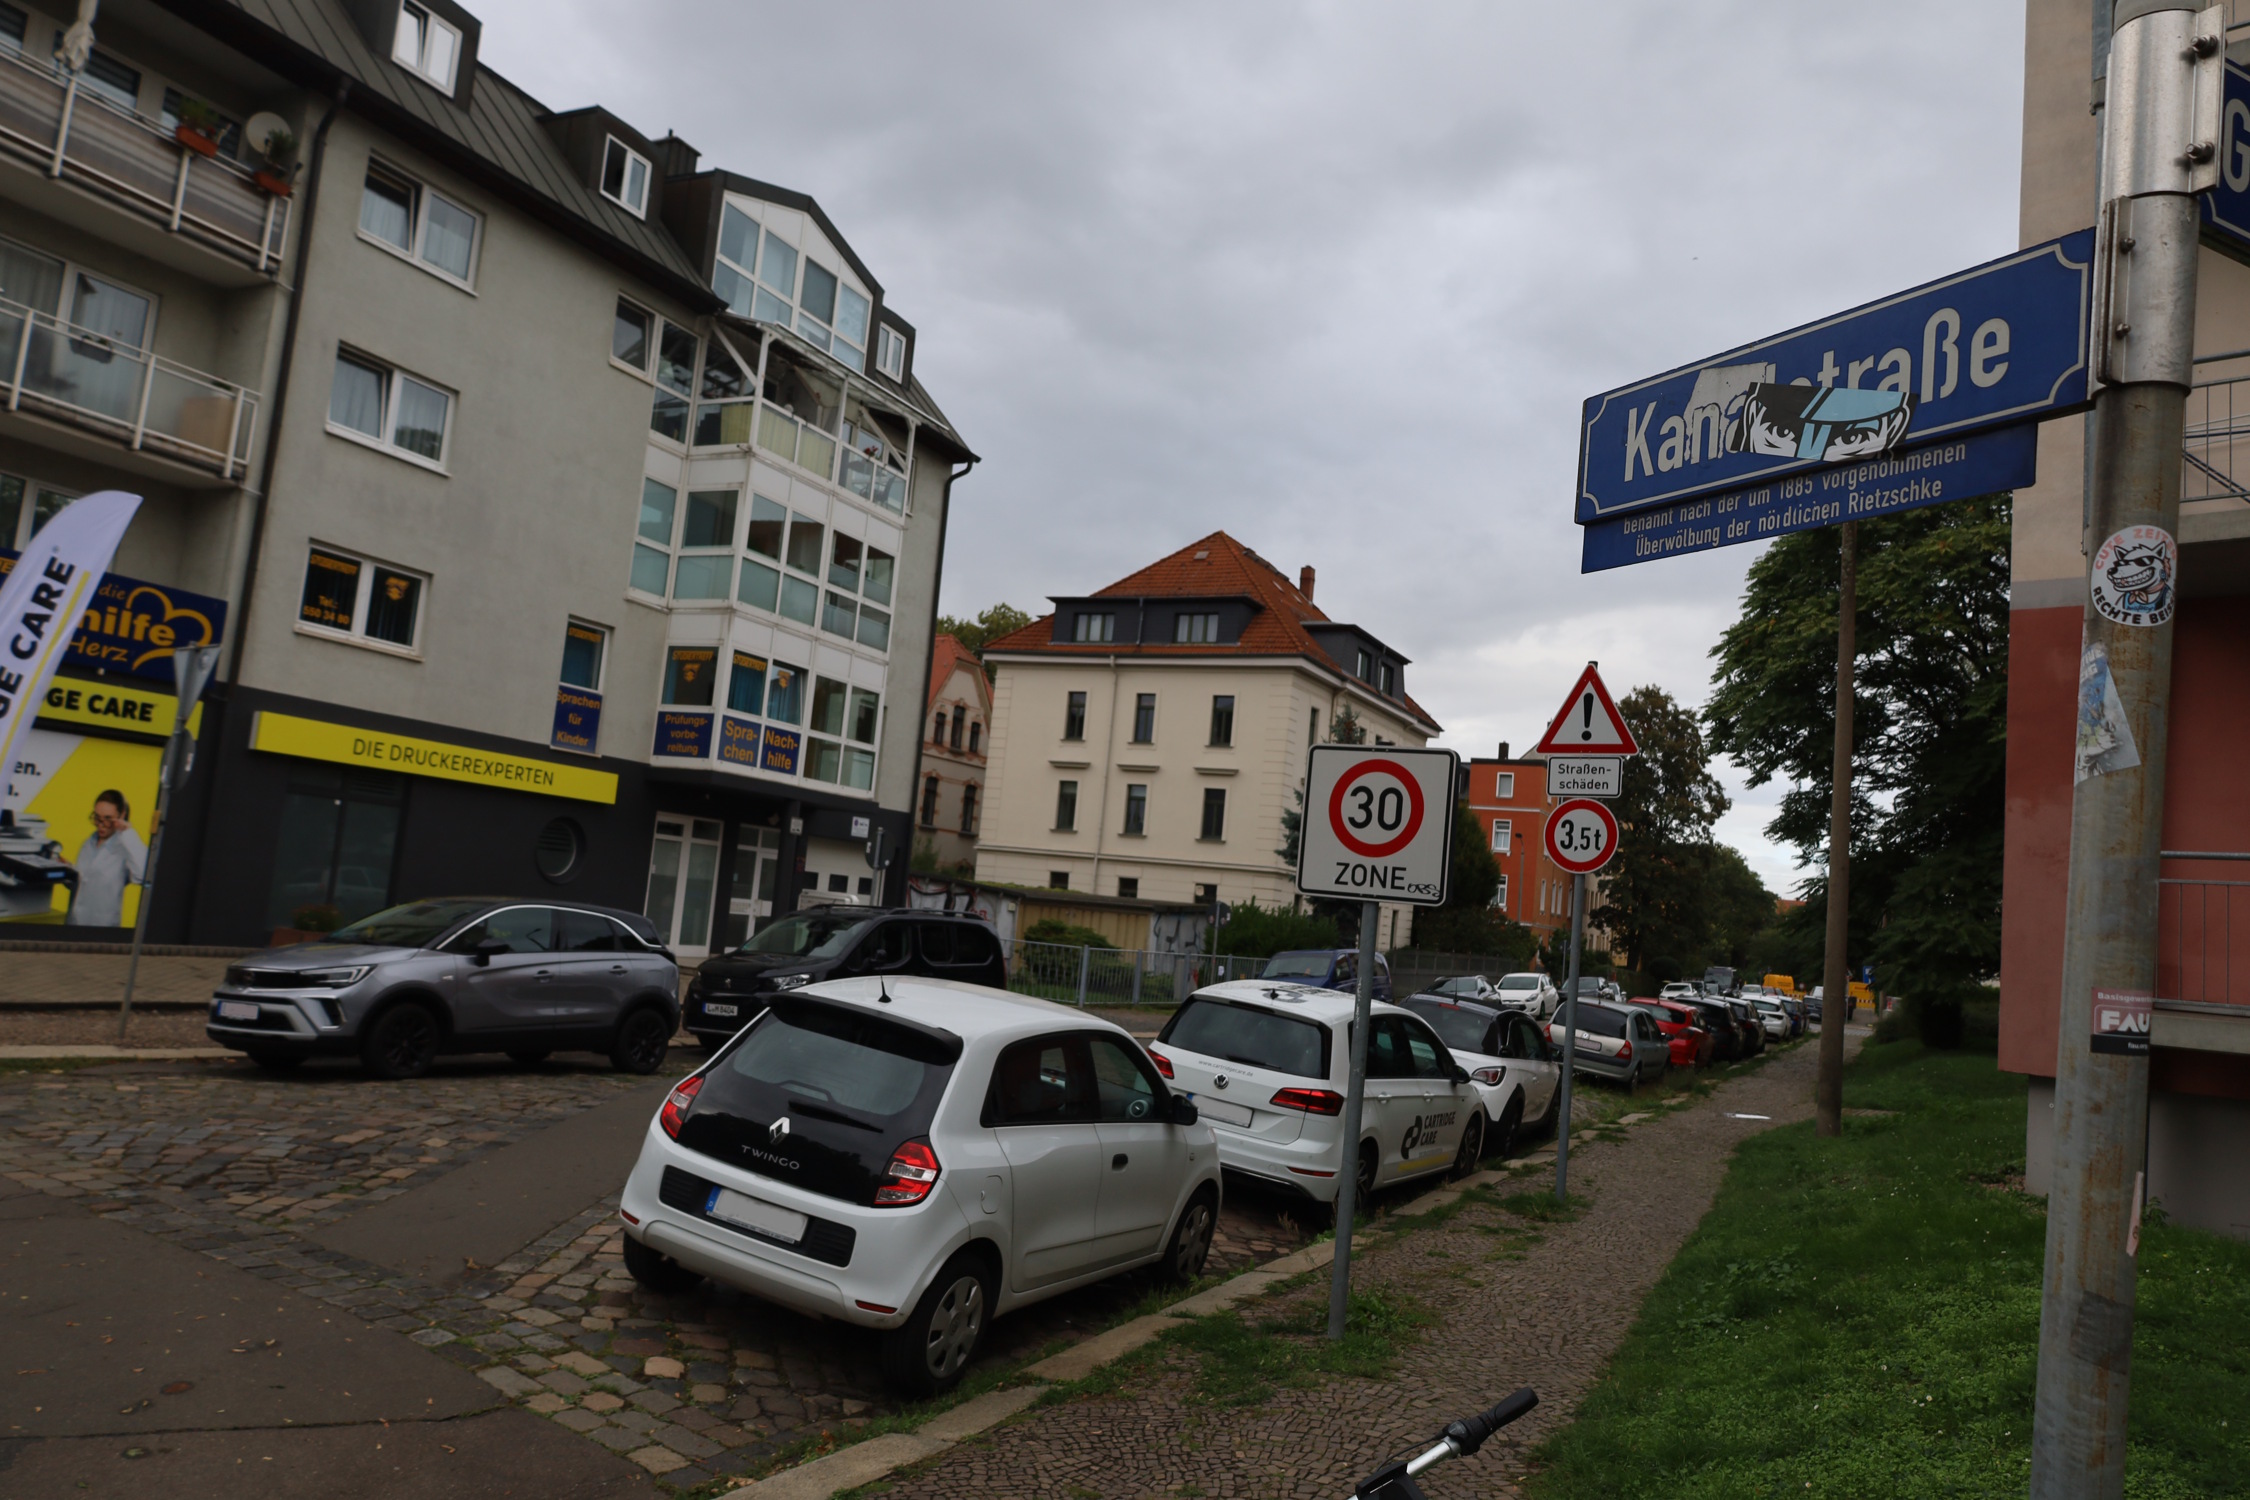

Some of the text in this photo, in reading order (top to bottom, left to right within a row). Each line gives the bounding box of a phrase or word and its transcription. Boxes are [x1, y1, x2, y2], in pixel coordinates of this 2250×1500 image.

[1624, 509, 1673, 535] benannt
[1680, 499, 1711, 522] nach
[1718, 493, 1741, 515] der
[1749, 488, 1770, 507] um
[1779, 476, 1813, 500] 1885
[1636, 527, 1720, 557] Überwölbung
[1727, 517, 1750, 539] der
[1848, 477, 1943, 515] Rietzschke
[2095, 533, 2125, 570] CUTE
[98, 583, 126, 600] die
[10, 556, 76, 660] CARE
[2093, 586, 2142, 624] RECHTE
[88, 694, 155, 722] CARE
[557, 690, 600, 709] Sprachen
[568, 712, 583, 725] für
[556, 730, 589, 746] Kinder
[725, 720, 757, 742] Spra-
[765, 729, 798, 750] Nach-
[353, 738, 554, 786] DIE DRUCKEREXPERTEN
[724, 744, 754, 762] chen
[767, 751, 791, 770] hilfe
[1558, 763, 1612, 777] Straßen-
[1559, 777, 1609, 791] schäden
[1348, 785, 1404, 832] 30
[1334, 862, 1407, 891] ZONE
[2101, 1010, 2150, 1033] FAU
[1424, 1111, 1457, 1129] CARTRIDGE
[1420, 1130, 1438, 1146] CARE
[741, 1144, 800, 1170] TWINGO
